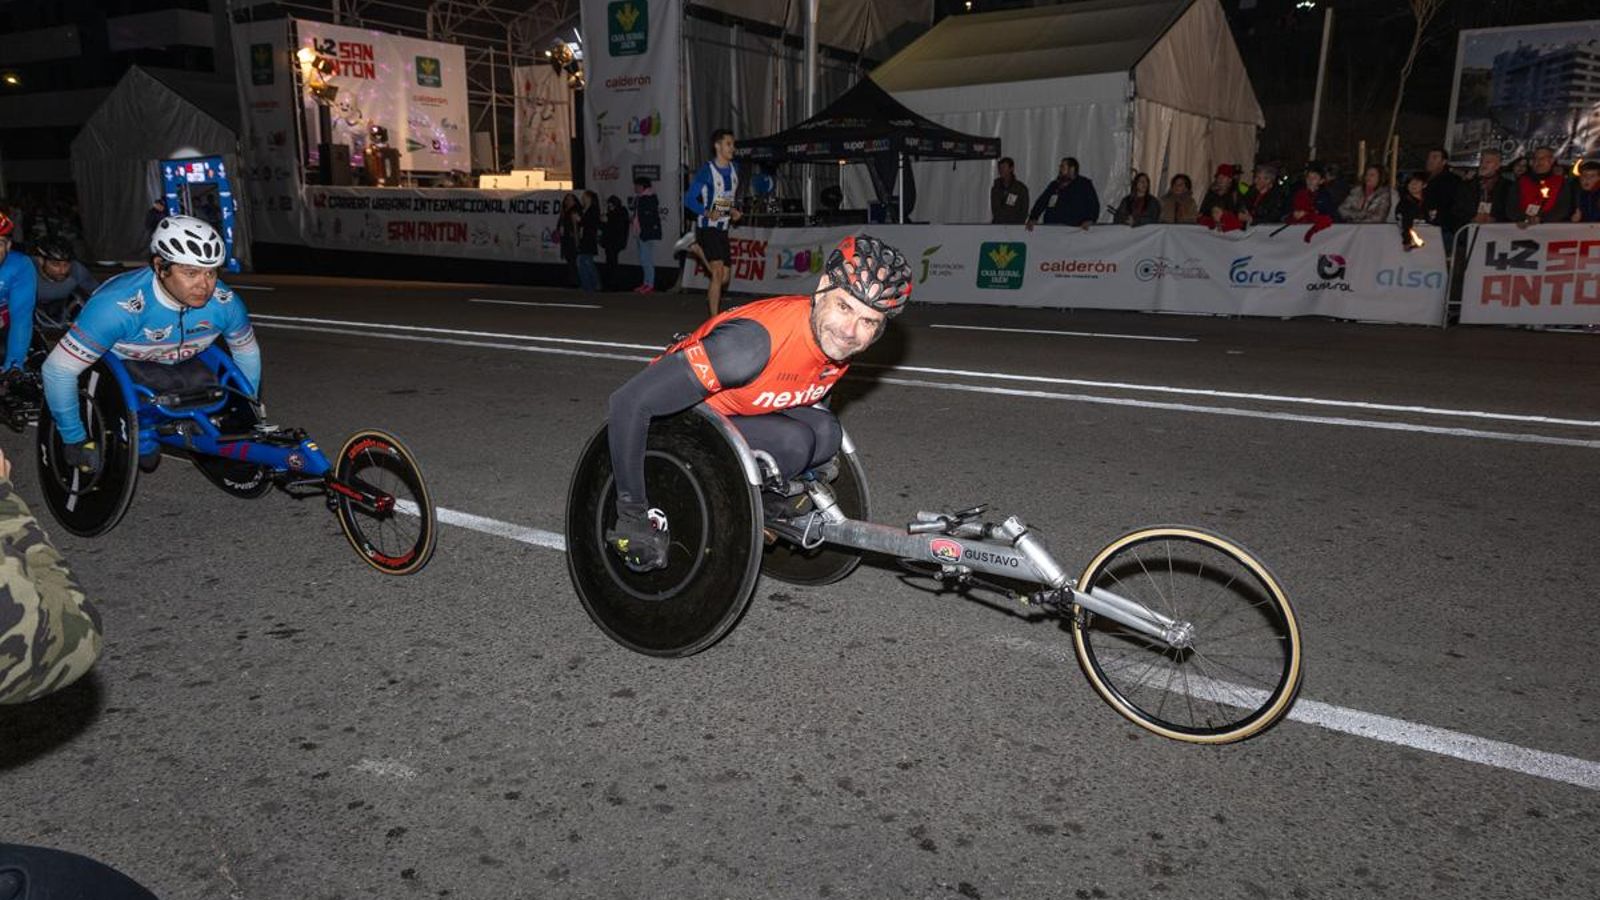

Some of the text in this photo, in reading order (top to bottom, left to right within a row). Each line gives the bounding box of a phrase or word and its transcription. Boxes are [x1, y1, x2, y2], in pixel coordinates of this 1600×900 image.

[313, 37, 375, 61] 42 SAN
[328, 58, 376, 80] NTON
[413, 198, 506, 213] INTERNACIONAL
[509, 200, 550, 215] NOCHE
[553, 201, 561, 214] D
[387, 221, 416, 241] SAN
[1040, 259, 1117, 273] calderón
[1485, 239, 1600, 272] 42 SA
[1376, 266, 1443, 289] alsa
[1481, 273, 1600, 307] ANTO
[964, 549, 1020, 569] GUSTAVO
